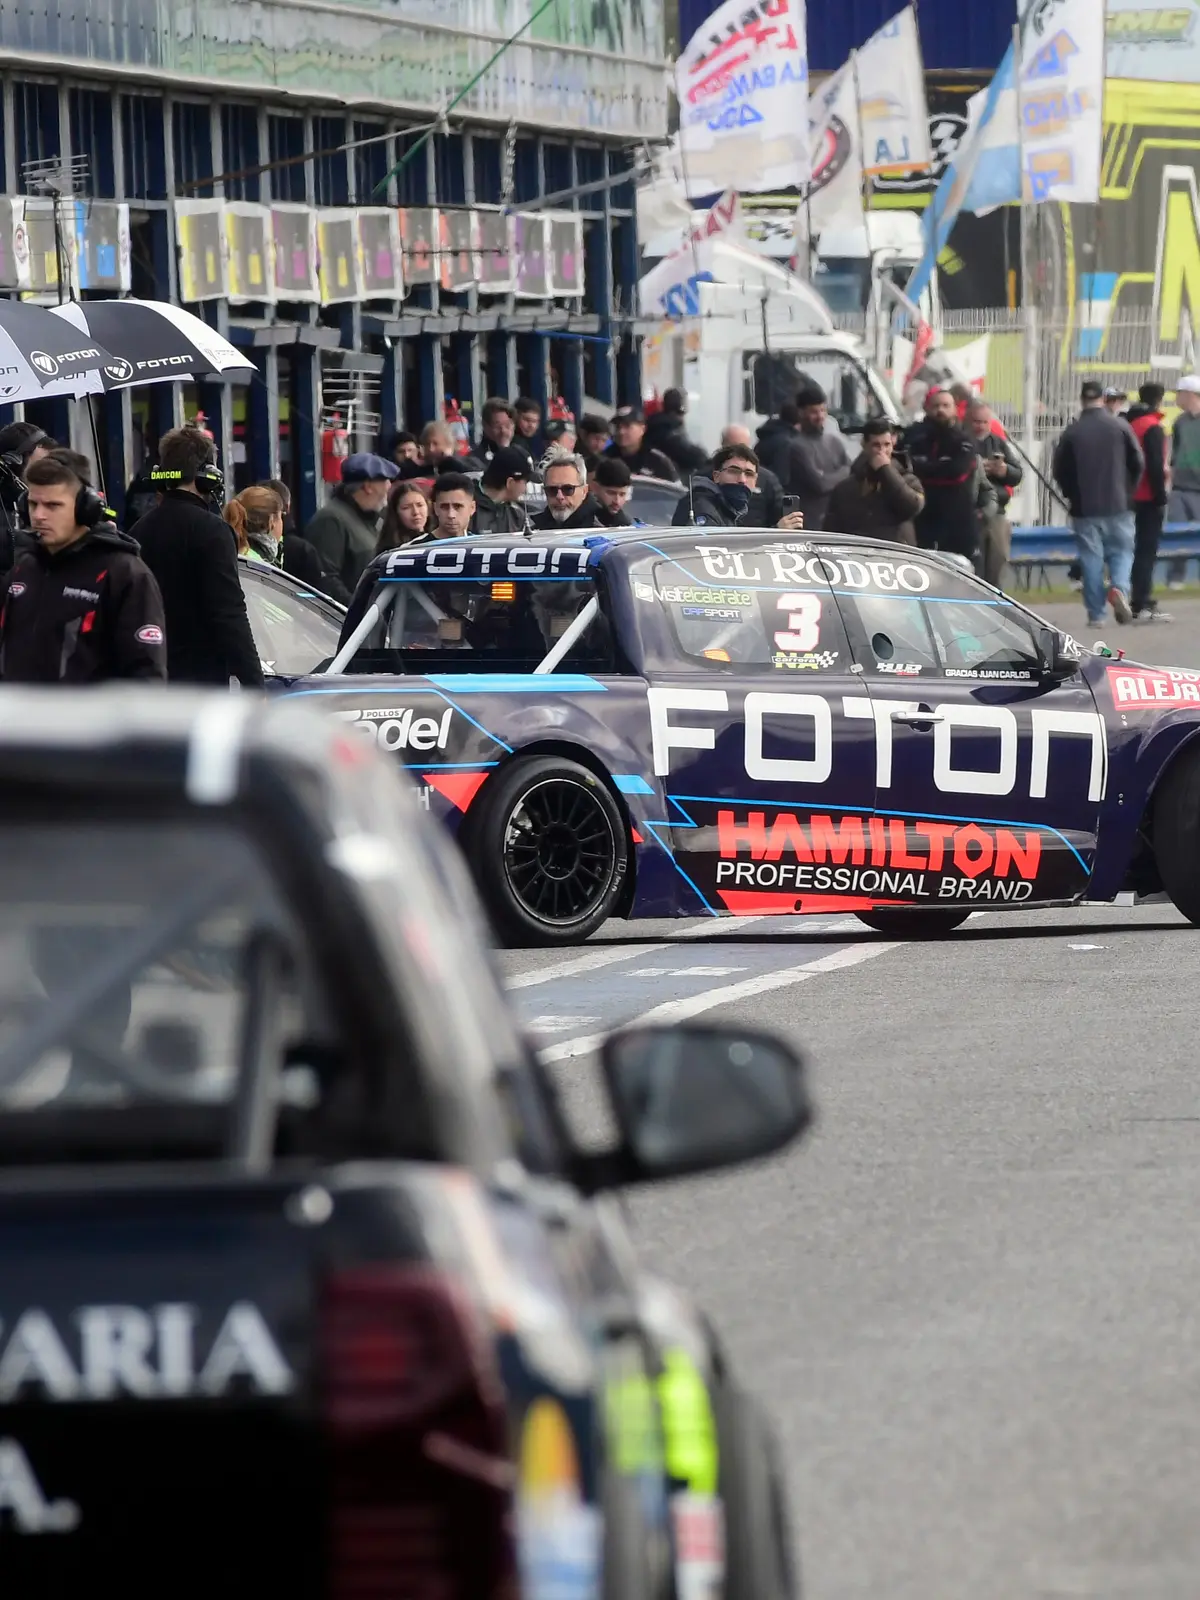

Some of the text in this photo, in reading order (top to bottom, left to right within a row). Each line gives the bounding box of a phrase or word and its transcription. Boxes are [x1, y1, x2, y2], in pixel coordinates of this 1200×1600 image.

[57, 349, 100, 363] FOTON
[136, 354, 193, 370] FOTON
[151, 471, 181, 480] DAVICOM
[385, 547, 592, 574] FOTON
[695, 545, 930, 592] EL RODEO
[774, 592, 822, 651] 3
[945, 668, 1031, 679] GRACIAS JUAN CARLOS
[1115, 676, 1200, 701] ALEJA
[647, 688, 1108, 802] FOTON
[718, 810, 1041, 879] HAMILTON
[716, 861, 1034, 901] PROFESSIONAL BRAND
[0, 1300, 295, 1403] ARIA
